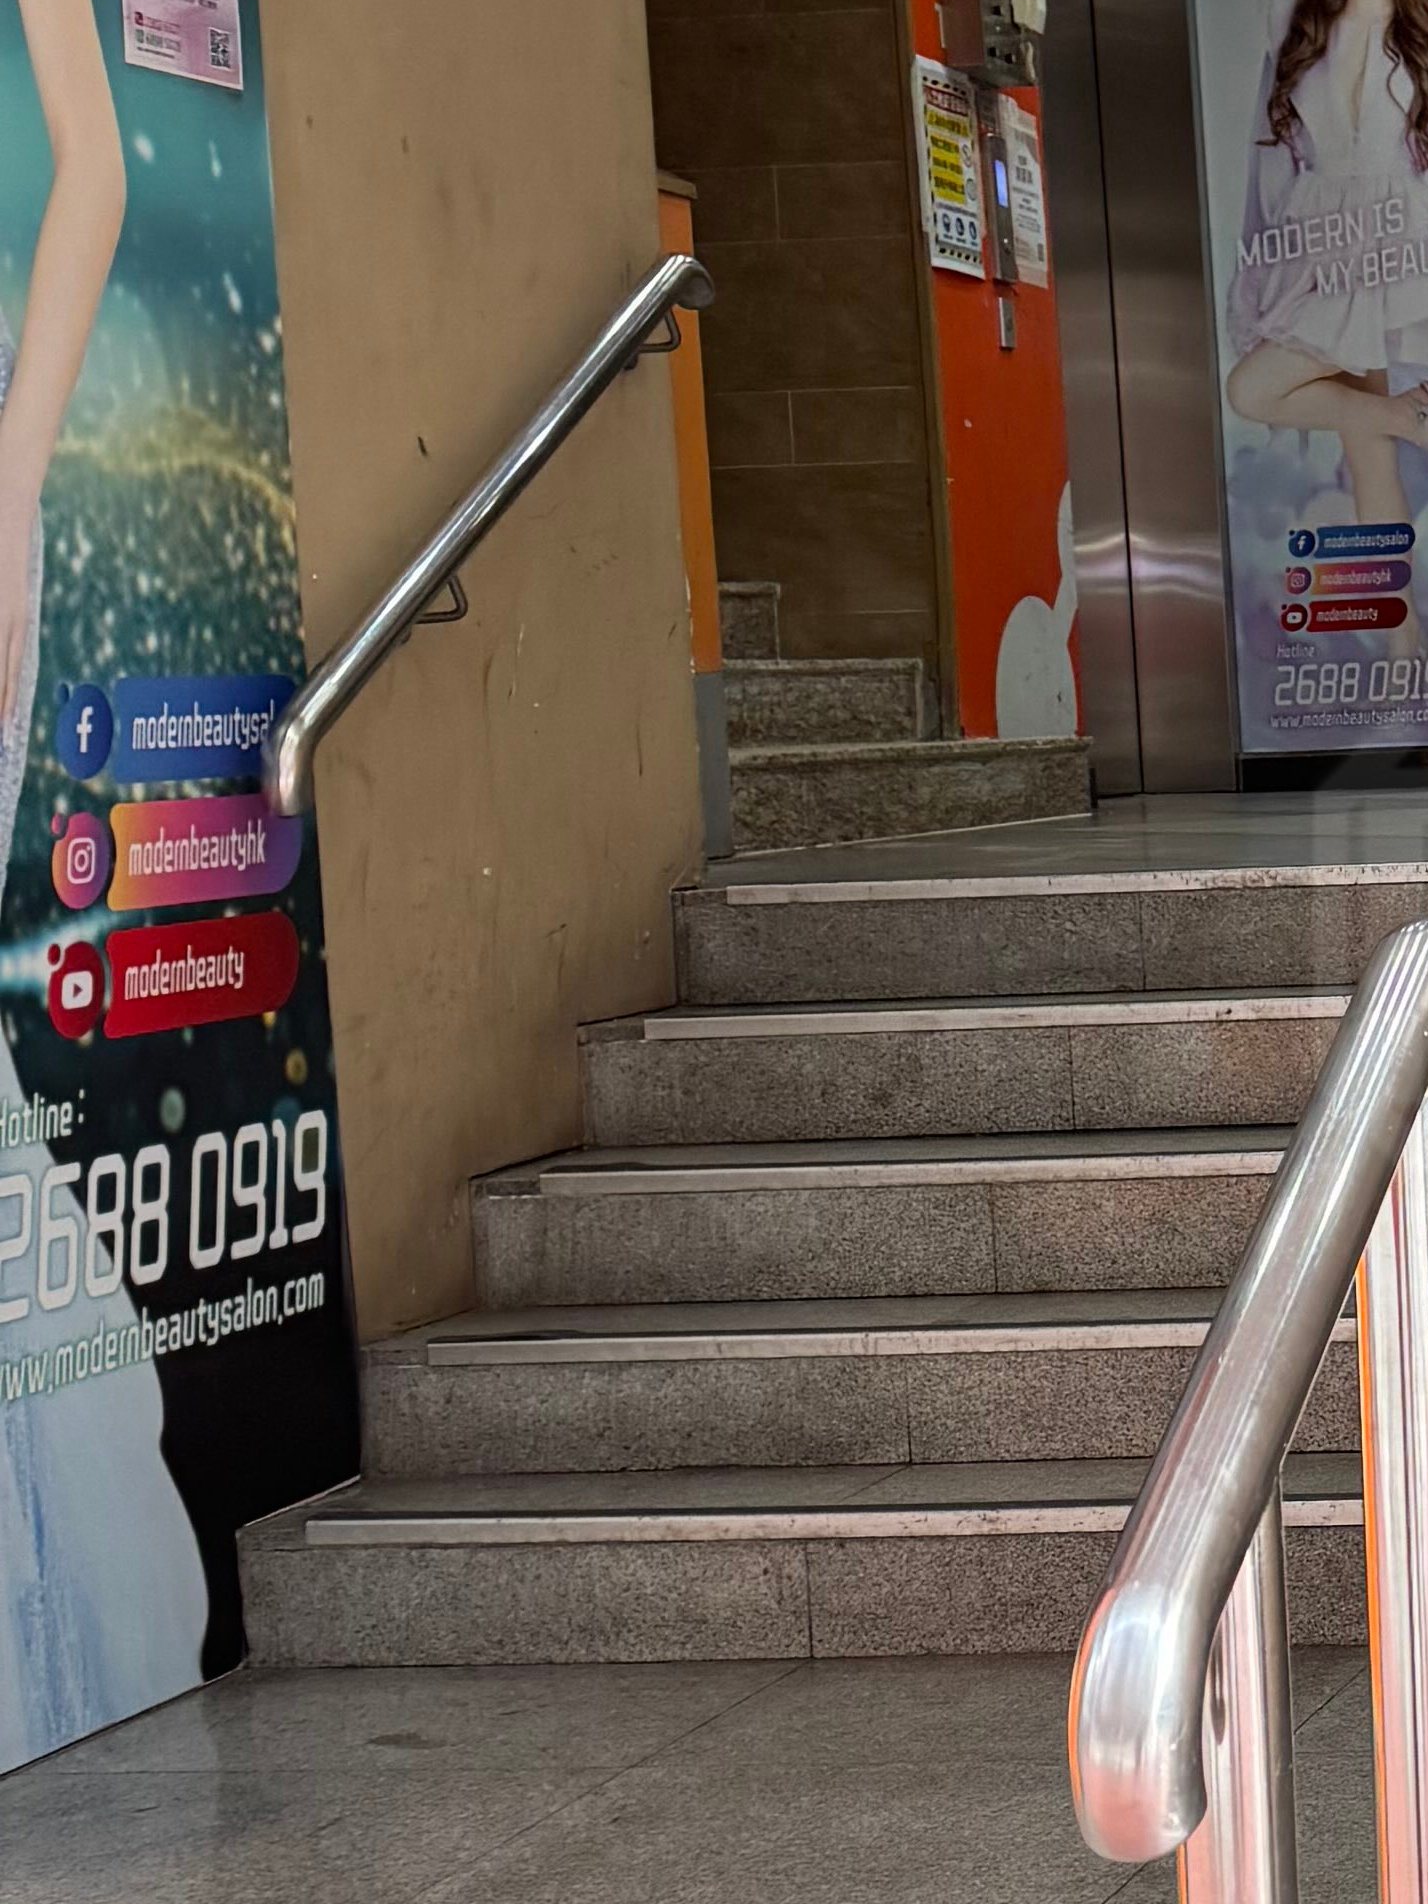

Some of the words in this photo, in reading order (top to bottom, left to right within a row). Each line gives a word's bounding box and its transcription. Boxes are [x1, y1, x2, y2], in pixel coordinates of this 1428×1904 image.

[1237, 207, 1365, 272] MODERN
[1372, 198, 1405, 238] IS
[1316, 257, 1355, 297] MY
[1323, 531, 1409, 549] modernbeautysalon
[1319, 568, 1392, 586] modernbeautyhk
[1316, 608, 1379, 623] modernbeauty
[1275, 662, 1361, 706] 2688
[128, 818, 267, 877] modernbeautyhk
[124, 944, 245, 1001] modernbeauty
[0, 1143, 171, 1324] 2688
[188, 1108, 328, 1270] 0919
[0, 1271, 325, 1401] ww.modernbeautysalon.com
